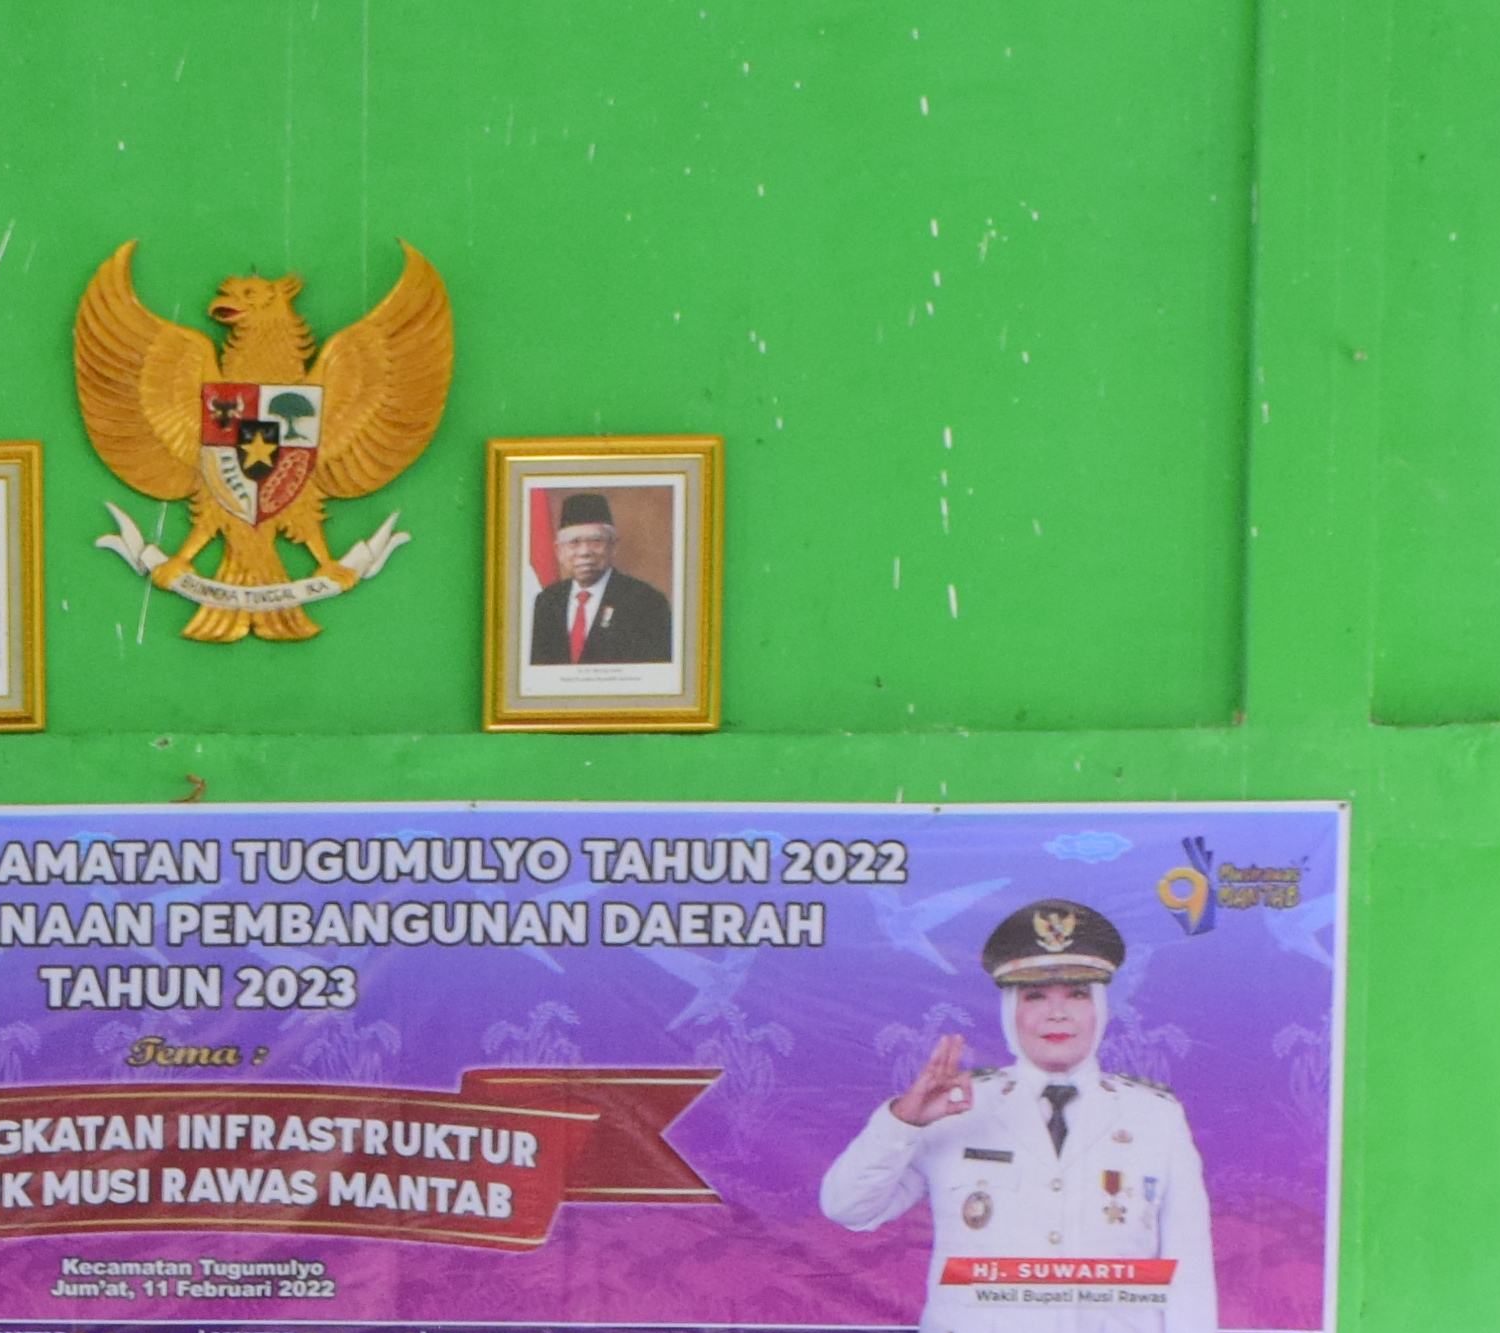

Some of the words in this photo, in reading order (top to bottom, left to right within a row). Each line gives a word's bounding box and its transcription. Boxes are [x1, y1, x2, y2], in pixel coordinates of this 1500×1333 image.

[233, 837, 570, 884] TUGUMULYO
[583, 838, 770, 884] TAHUN
[781, 838, 908, 884] 2022
[167, 902, 588, 947] PEMBANGUNAN
[601, 902, 825, 947] DAERAH
[40, 965, 222, 1009] TAHUN
[233, 965, 358, 1009] 2023
[125, 1036, 242, 1067] Tema
[178, 1114, 538, 1168] INFRASTRUKTUR
[42, 1168, 150, 1206] MUSI
[161, 1167, 319, 1206] RAWAS
[328, 1170, 513, 1219] MANTAB
[61, 1258, 192, 1276] Kecamatan
[199, 1258, 325, 1280] Tugumulyo
[972, 1263, 1008, 1282] Hj.
[1017, 1263, 1136, 1279] SUWARTI
[142, 1280, 169, 1297] 11
[175, 1279, 272, 1298] Februari
[277, 1280, 335, 1298] 2022
[975, 1288, 1019, 1303] Wakil
[1023, 1289, 1075, 1306] Bupati
[1078, 1289, 1114, 1303] Musi
[1118, 1290, 1168, 1304] Rawas
